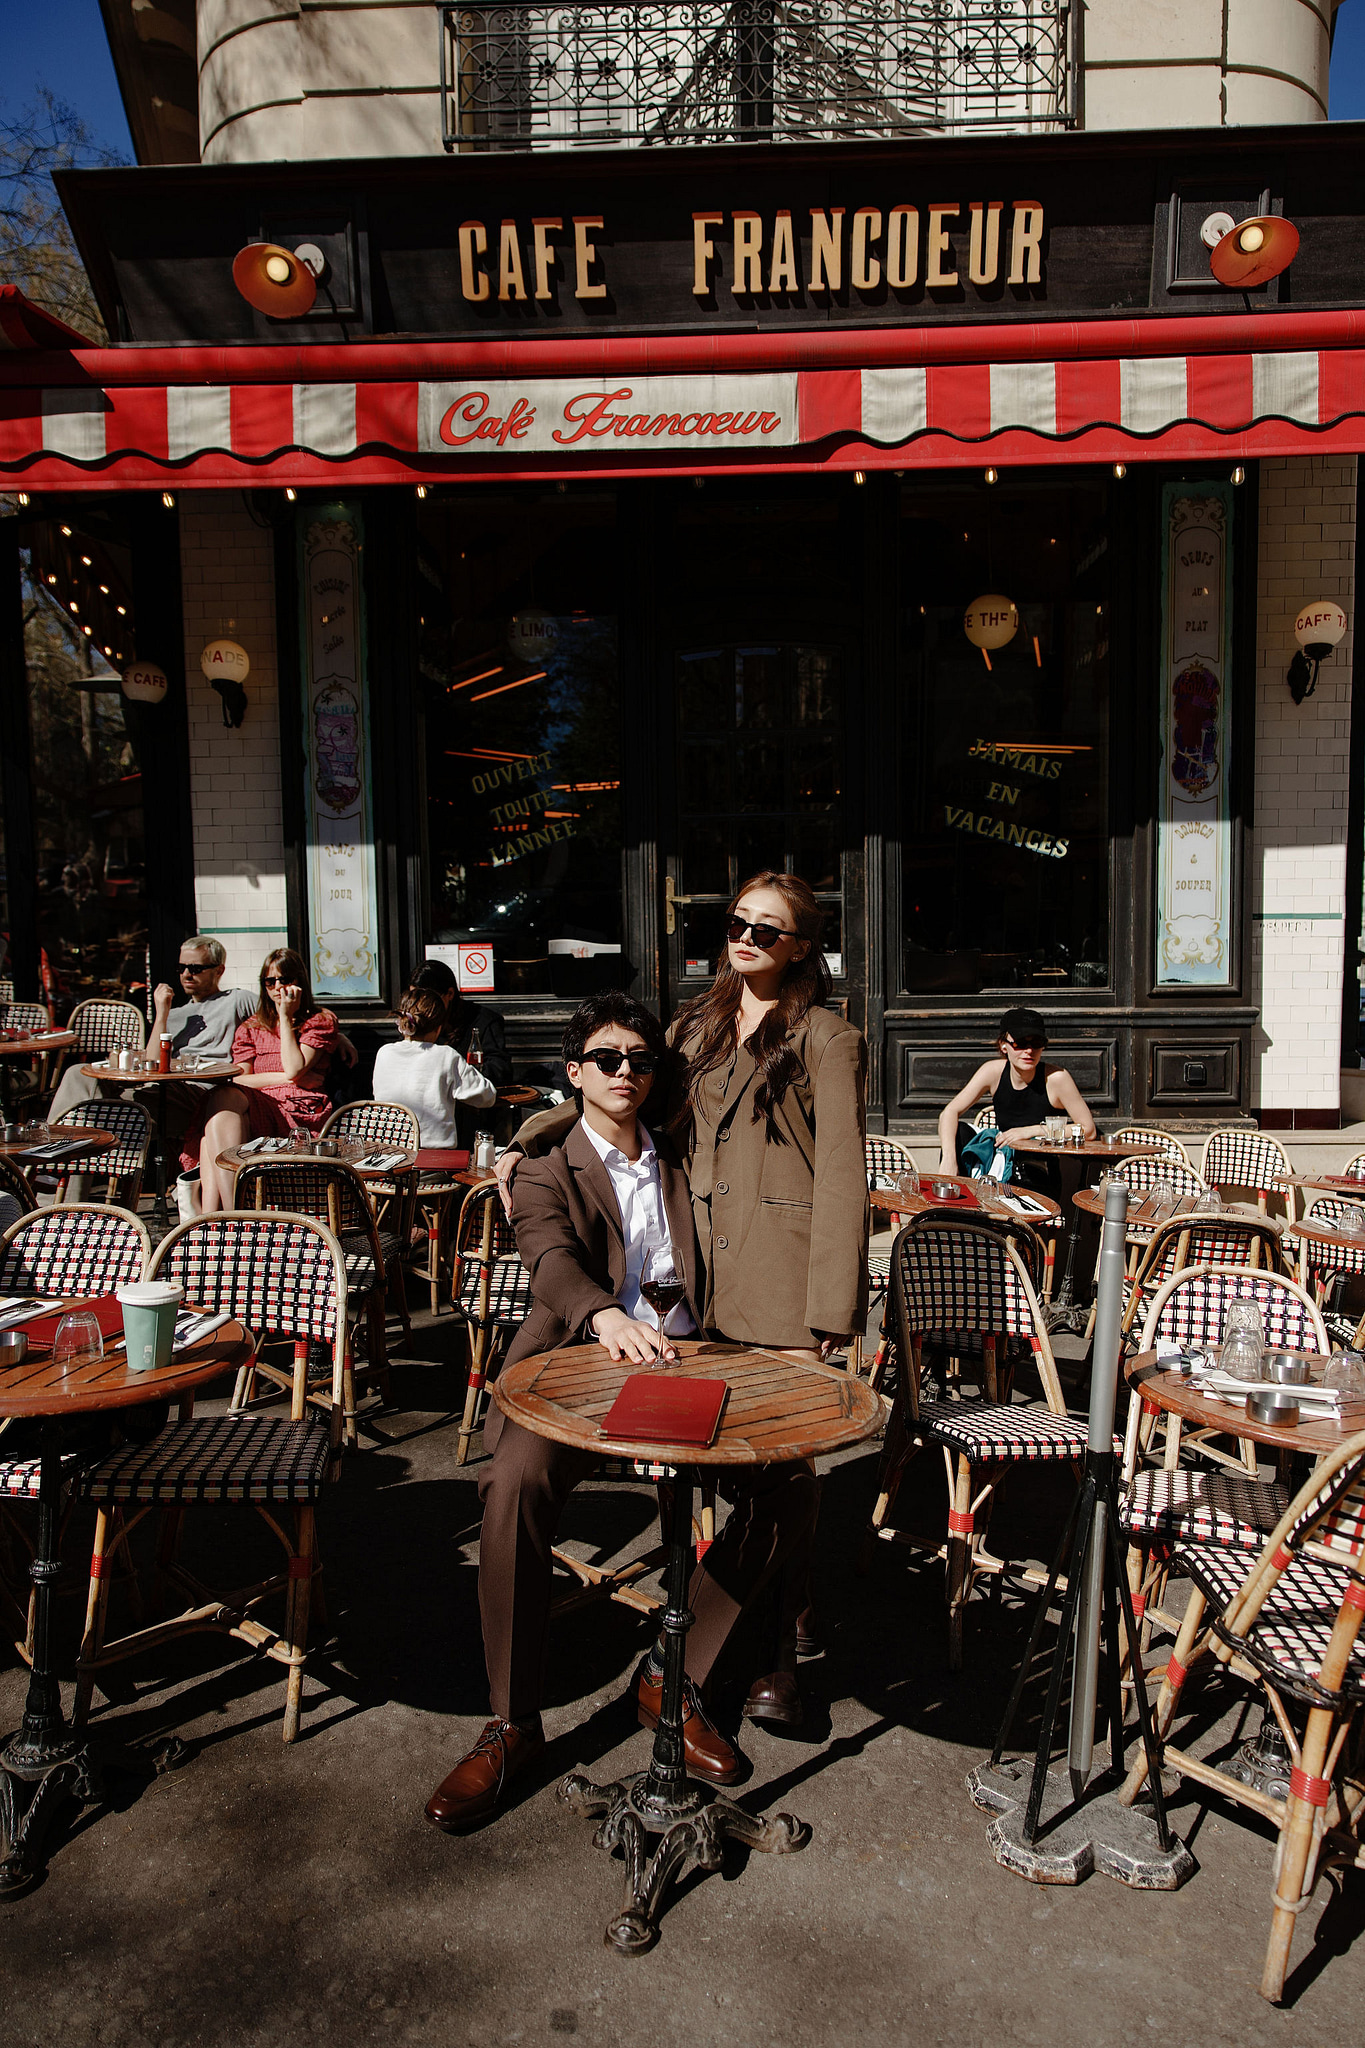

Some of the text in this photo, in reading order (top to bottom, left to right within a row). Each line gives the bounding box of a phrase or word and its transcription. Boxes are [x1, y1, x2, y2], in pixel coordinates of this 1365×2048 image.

[458, 201, 1043, 300] CAFE FRANCOEUR
[440, 391, 537, 446] Café
[1185, 621, 1208, 631] PLAT
[134, 672, 165, 688] CAFE
[471, 750, 553, 795] OUVERT
[968, 738, 1063, 780] JAMAIS
[489, 789, 556, 824] TOUTE
[986, 781, 1021, 806] EN
[944, 805, 1070, 859] VACANCES
[330, 889, 352, 901] JOUR
[1175, 880, 1211, 891] SOUPER
